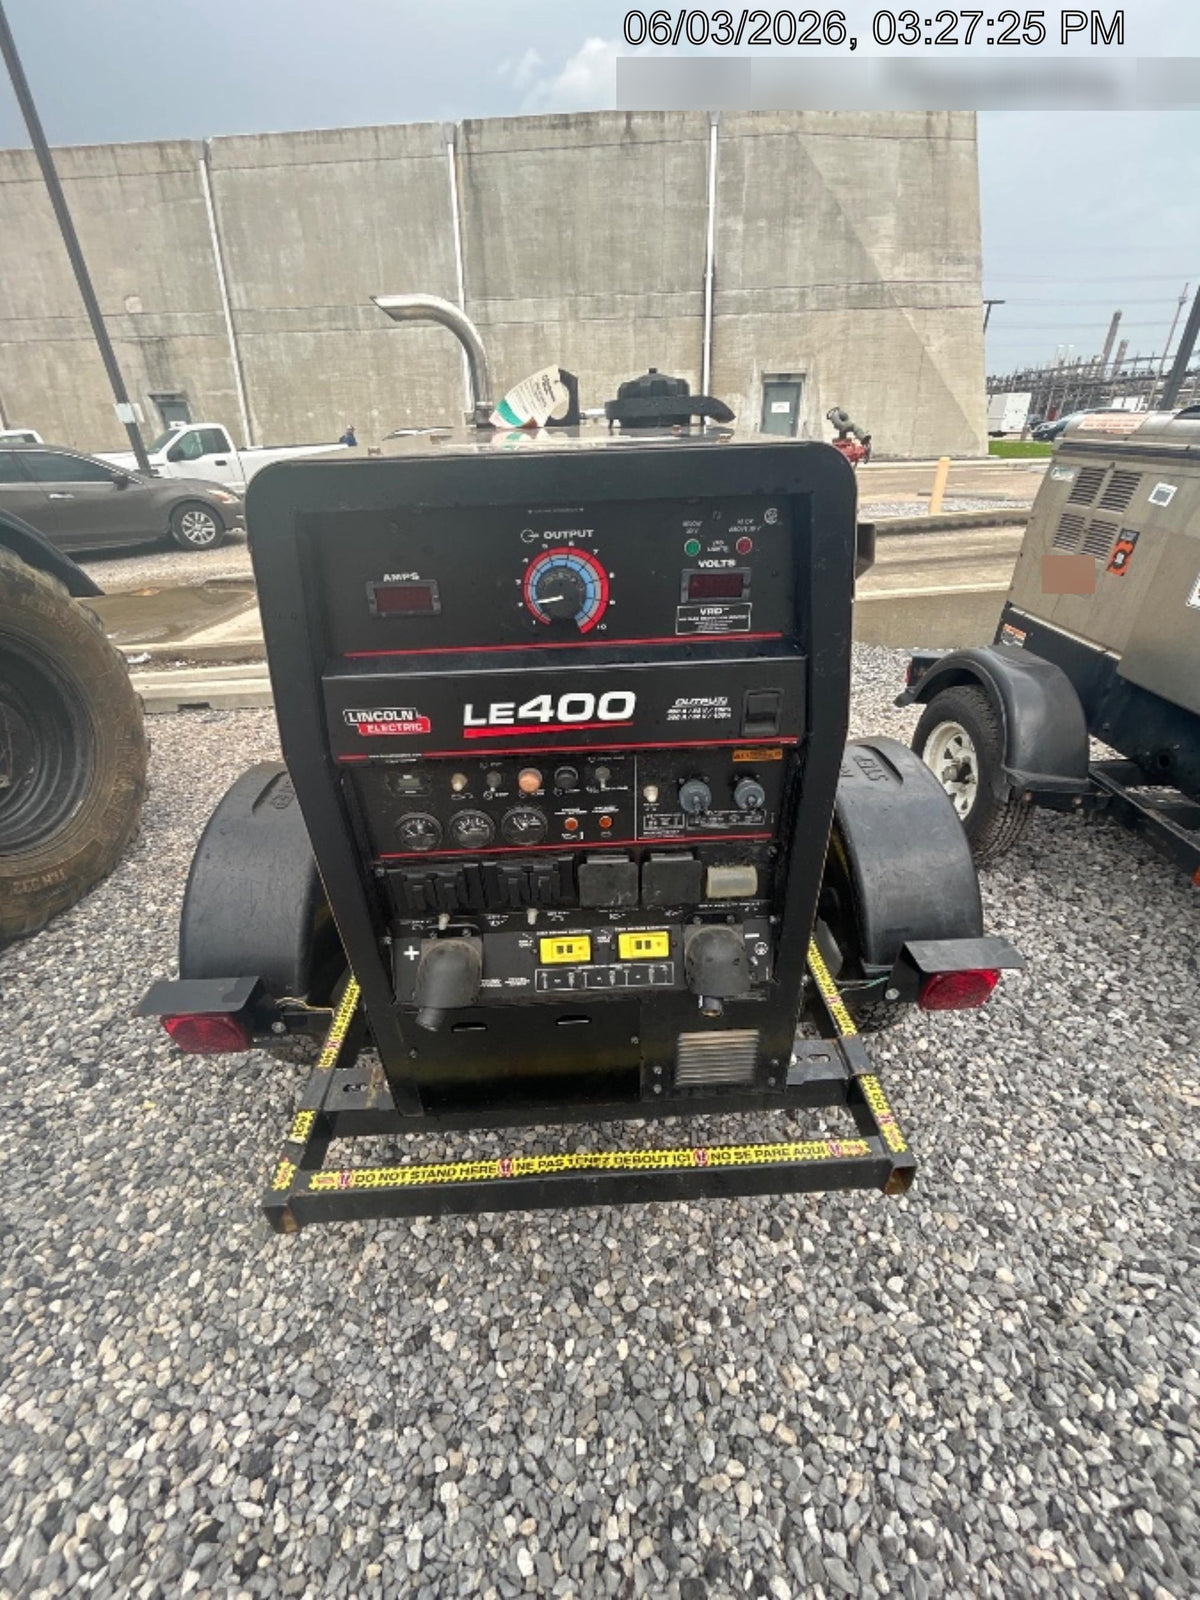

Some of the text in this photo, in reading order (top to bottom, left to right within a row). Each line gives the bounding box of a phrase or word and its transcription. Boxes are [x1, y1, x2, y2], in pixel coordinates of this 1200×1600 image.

[543, 529, 595, 540] OUTPUT
[698, 559, 736, 568] VOLTS
[383, 572, 420, 582] AMPS
[463, 691, 637, 726] LE400
[346, 710, 414, 723] LINCOLN
[366, 722, 423, 733] ELECTRIC
[711, 1145, 825, 1160] NO SE PARE AQUI
[516, 1162, 534, 1171] NE
[538, 1159, 563, 1168] PAS
[615, 1155, 670, 1164] DEBOUT
[674, 1154, 690, 1162] ICI
[379, 1172, 407, 1181] NOT
[411, 1167, 457, 1180] STAND
[460, 1165, 497, 1175] HERE
